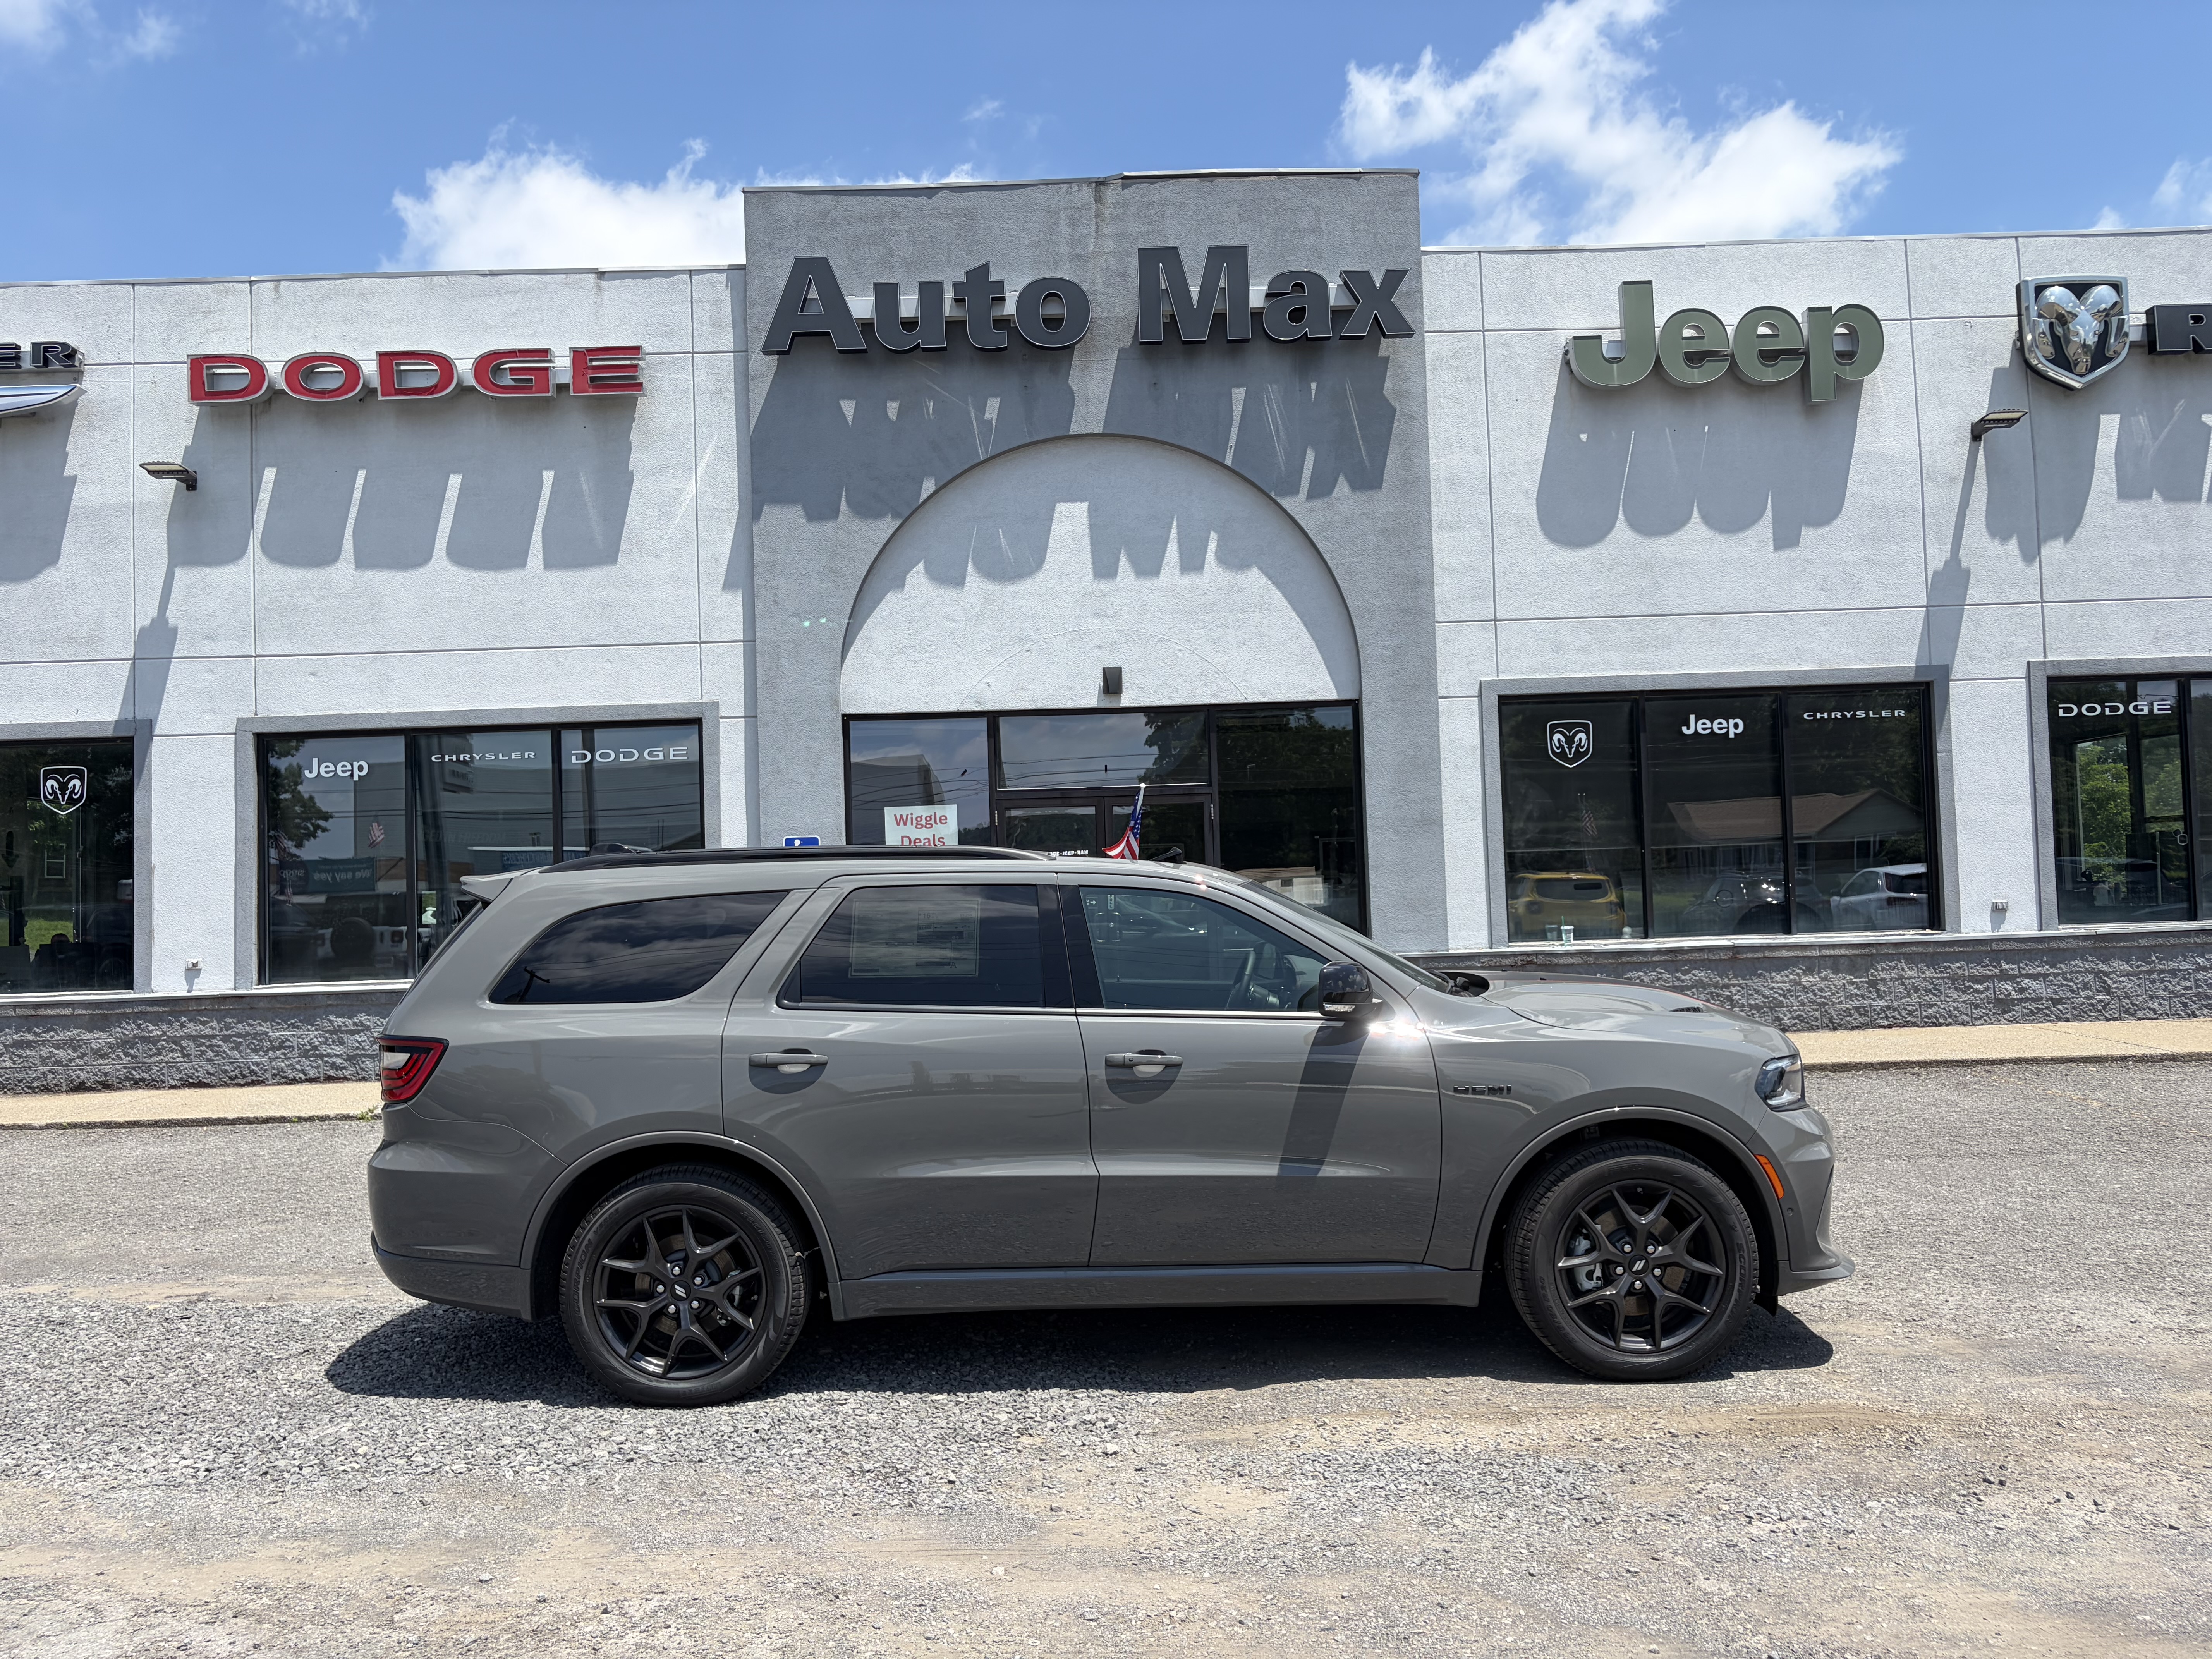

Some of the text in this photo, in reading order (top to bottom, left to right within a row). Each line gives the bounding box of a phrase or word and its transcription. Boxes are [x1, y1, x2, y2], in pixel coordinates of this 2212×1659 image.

[761, 245, 1417, 353] Auto Max
[1570, 280, 1884, 402] Jeep
[187, 345, 644, 404] DODGE
[1803, 710, 1906, 720] CHRYSLER
[2058, 701, 2172, 717] DODGE
[1682, 714, 1744, 738] Jeep
[431, 752, 536, 762] CHRYSLER
[572, 747, 688, 763] DODGE
[304, 757, 369, 781] Jeep
[894, 812, 948, 830] Wiggle
[901, 834, 945, 847] Deals
[1453, 1085, 1511, 1094] HEMI
